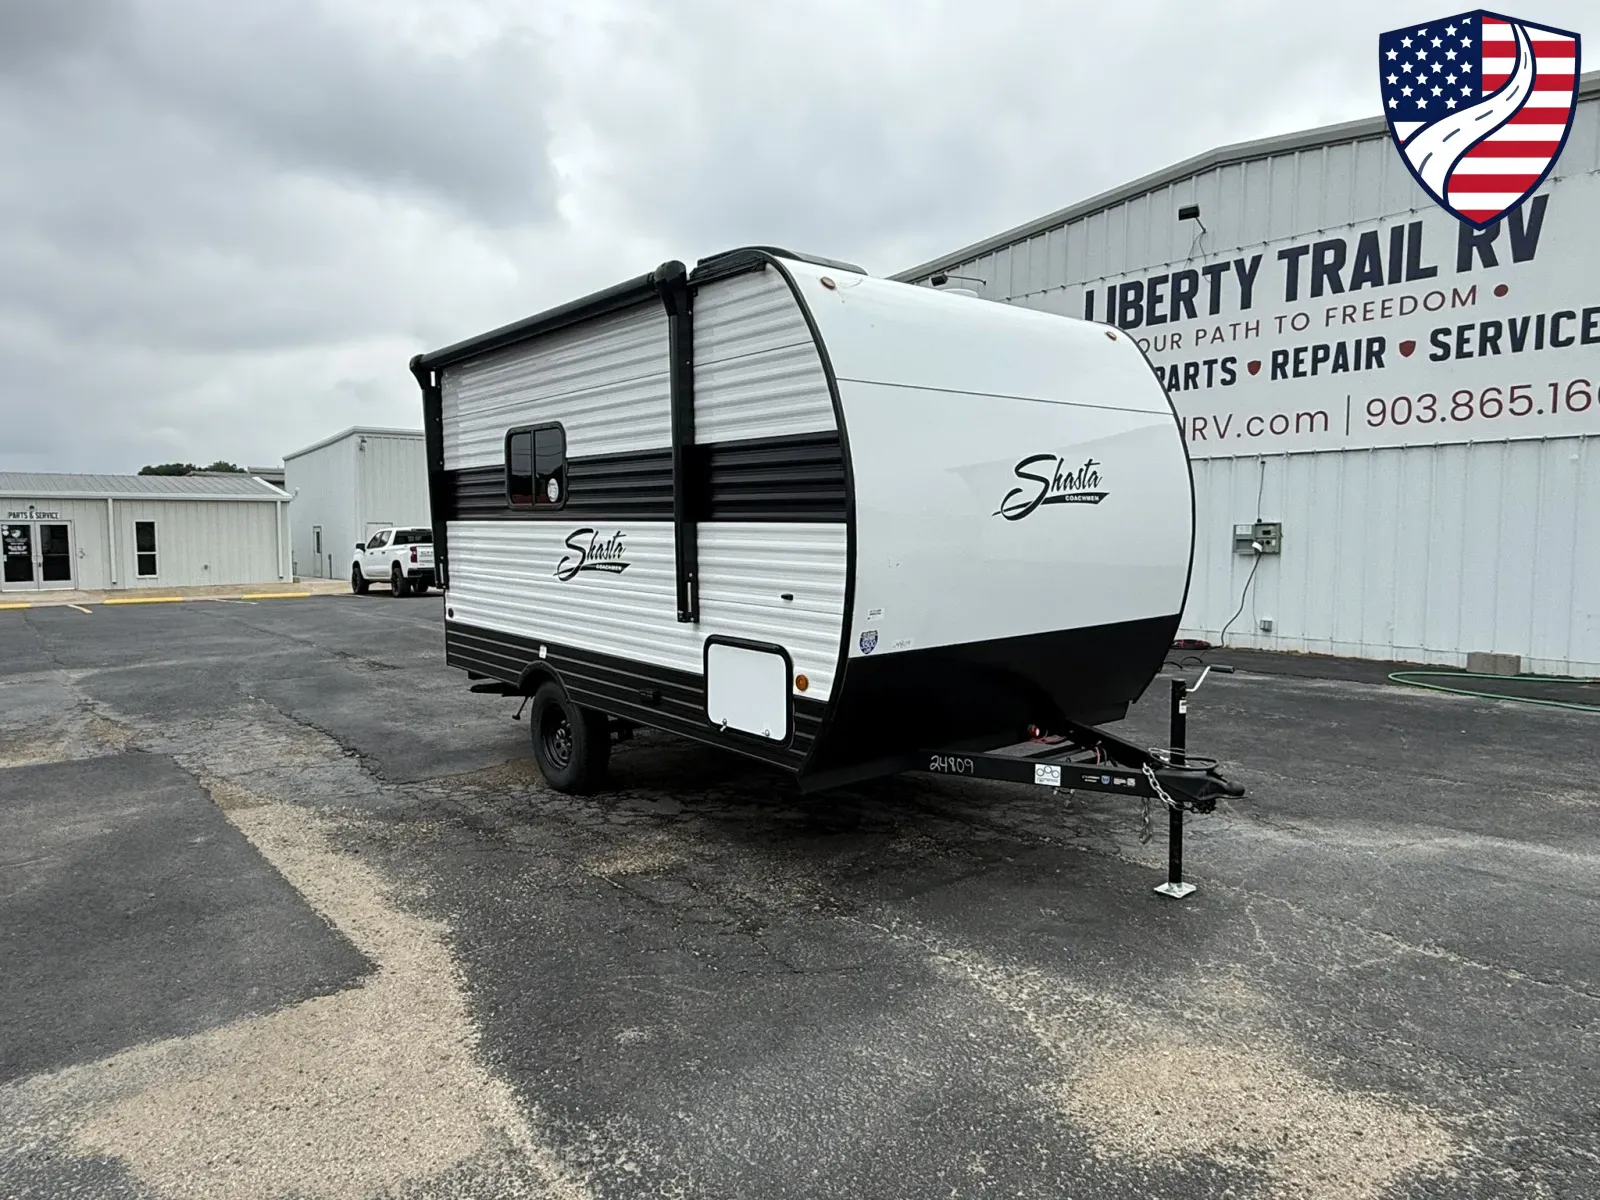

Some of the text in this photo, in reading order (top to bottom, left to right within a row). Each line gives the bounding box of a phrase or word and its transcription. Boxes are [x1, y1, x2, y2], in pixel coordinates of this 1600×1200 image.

[1085, 194, 1550, 331] LIBERTY TRAIL RV
[1195, 320, 1260, 346] PATH
[1275, 311, 1310, 335] TO
[1325, 285, 1477, 325] FREEDOM
[1270, 336, 1387, 381] REPAIR
[1429, 307, 1600, 362] SERVICE
[1366, 379, 1600, 428] 903.865.16
[8, 511, 28, 519] PARTS
[35, 511, 59, 519] SERVICE
[996, 454, 1103, 521] Shasta
[555, 528, 627, 581] Shasta
[930, 755, 974, 774] 24809
